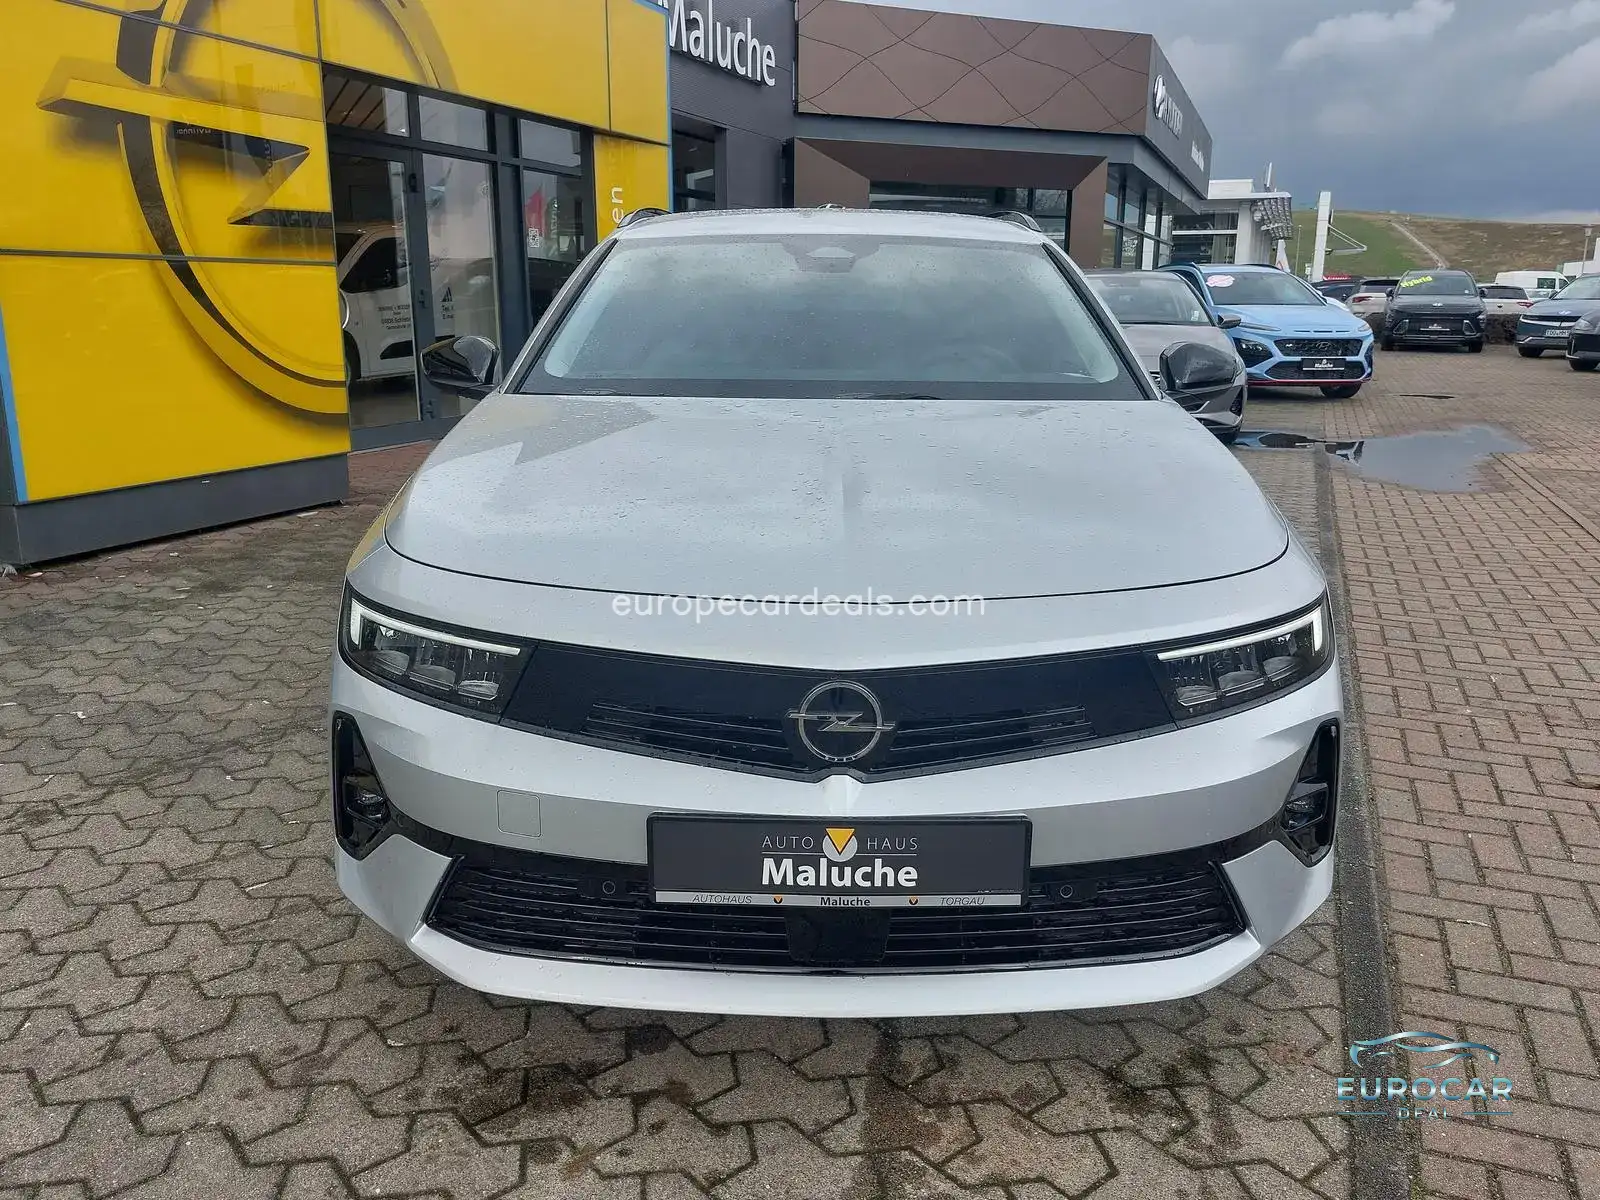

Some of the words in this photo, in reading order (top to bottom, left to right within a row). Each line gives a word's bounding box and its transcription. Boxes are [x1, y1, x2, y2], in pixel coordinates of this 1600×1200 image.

[658, 0, 776, 87] Maluche
[762, 835, 814, 849] AUTO
[867, 837, 918, 850] HAUS
[761, 857, 918, 887] Maluche
[691, 894, 753, 905] AUTOHAUS
[820, 897, 871, 906] Maluche
[939, 896, 986, 906] TORGAU
